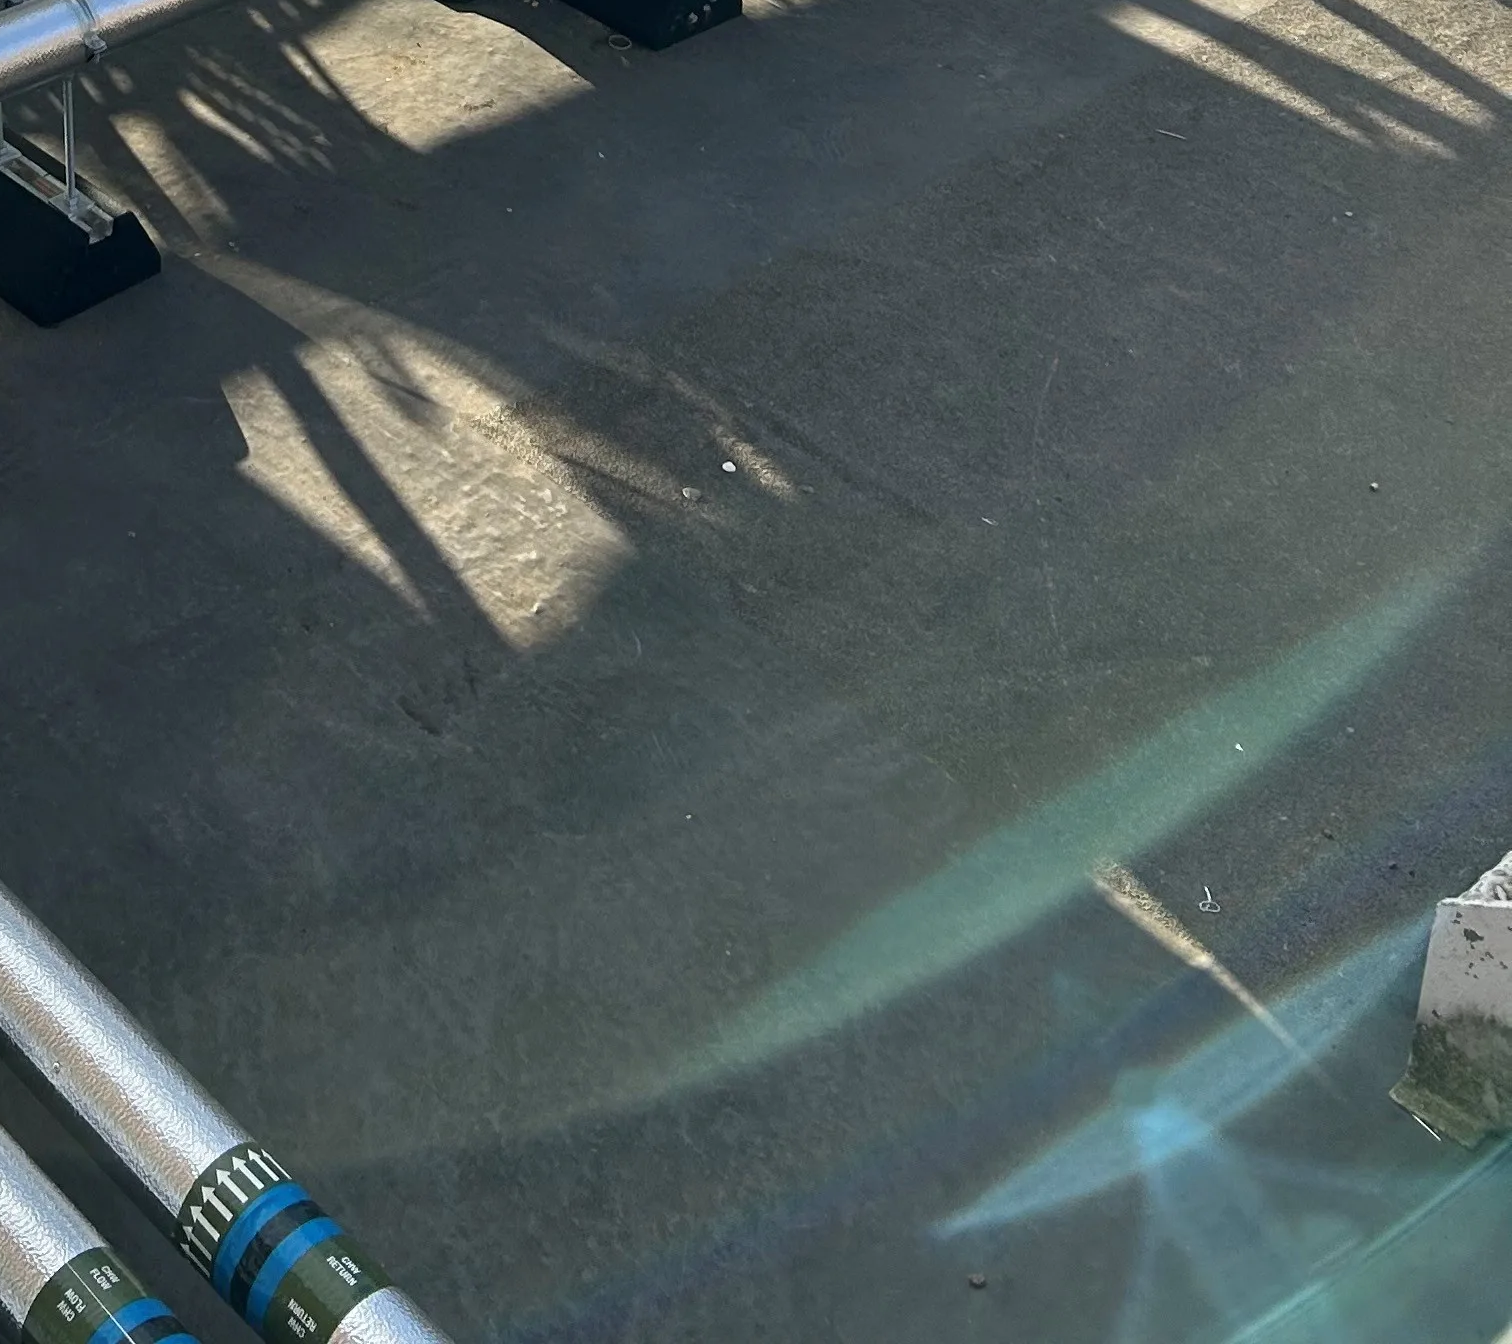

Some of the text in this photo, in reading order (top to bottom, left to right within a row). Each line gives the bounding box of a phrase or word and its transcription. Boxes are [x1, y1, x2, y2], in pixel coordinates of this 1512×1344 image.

[89, 1267, 112, 1290] FLOW
[100, 1265, 120, 1283] CHW
[326, 1255, 358, 1287] RETURN
[56, 1300, 75, 1322] CHW
[63, 1288, 87, 1314] FLOW
[287, 1298, 318, 1333] RETURN
[287, 1316, 306, 1338] CHW
